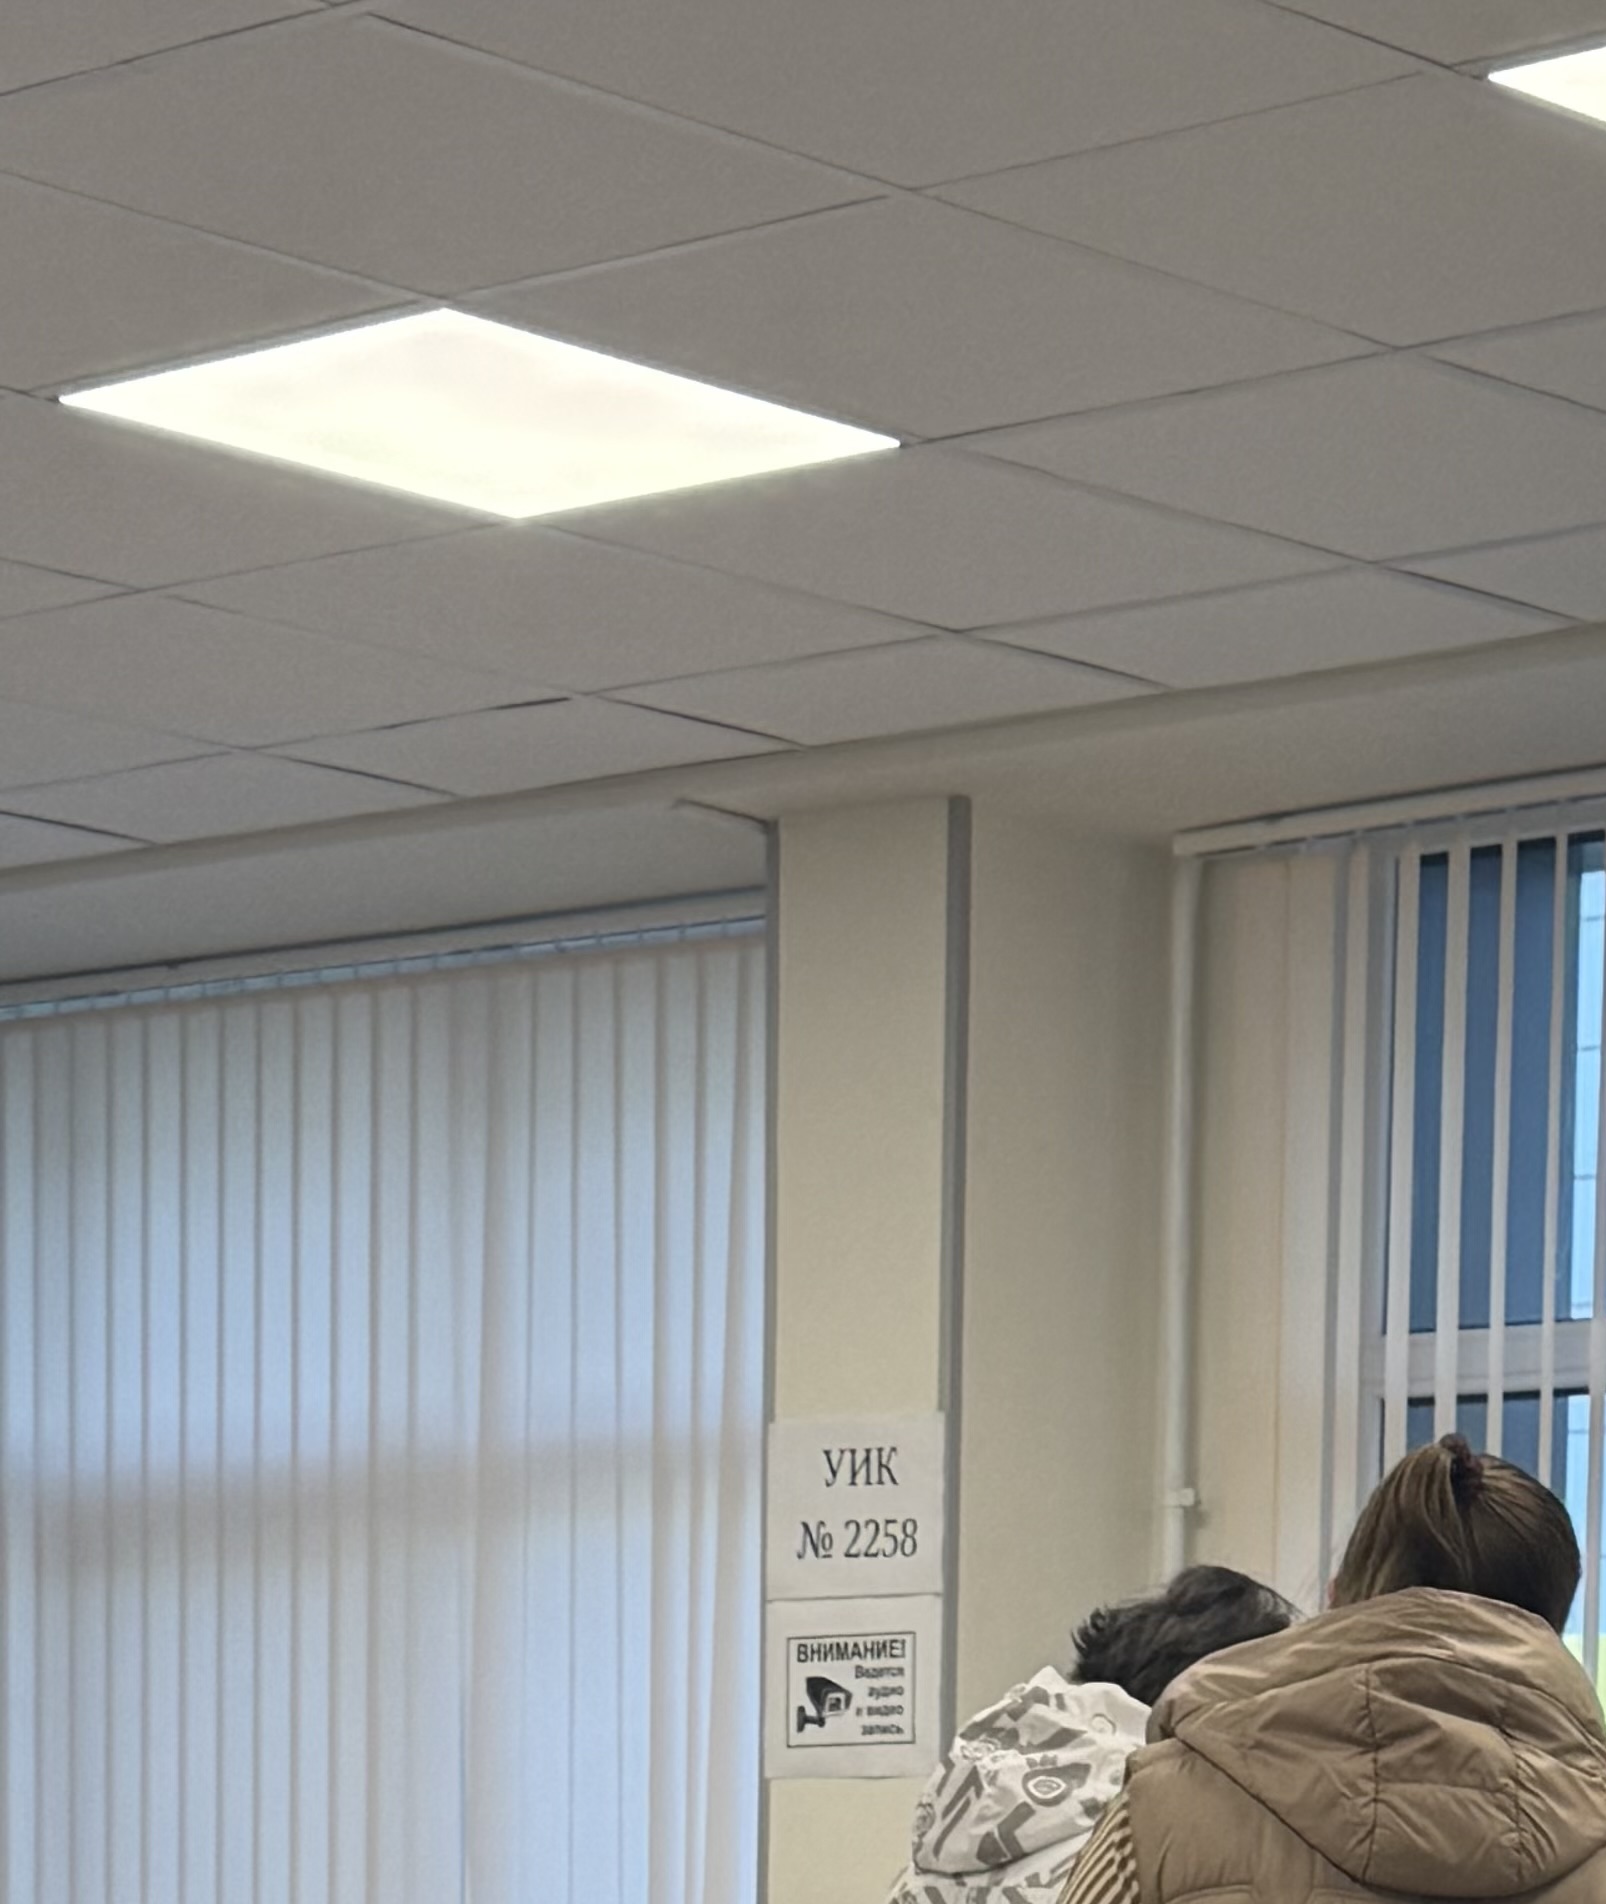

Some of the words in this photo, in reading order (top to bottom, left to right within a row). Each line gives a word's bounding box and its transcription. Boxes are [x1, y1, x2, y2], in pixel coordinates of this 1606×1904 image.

[822, 1446, 899, 1488] УИК
[796, 1519, 834, 1560] №
[843, 1518, 918, 1558] 2258
[797, 1638, 906, 1663] ВНИМАНИЕ!
